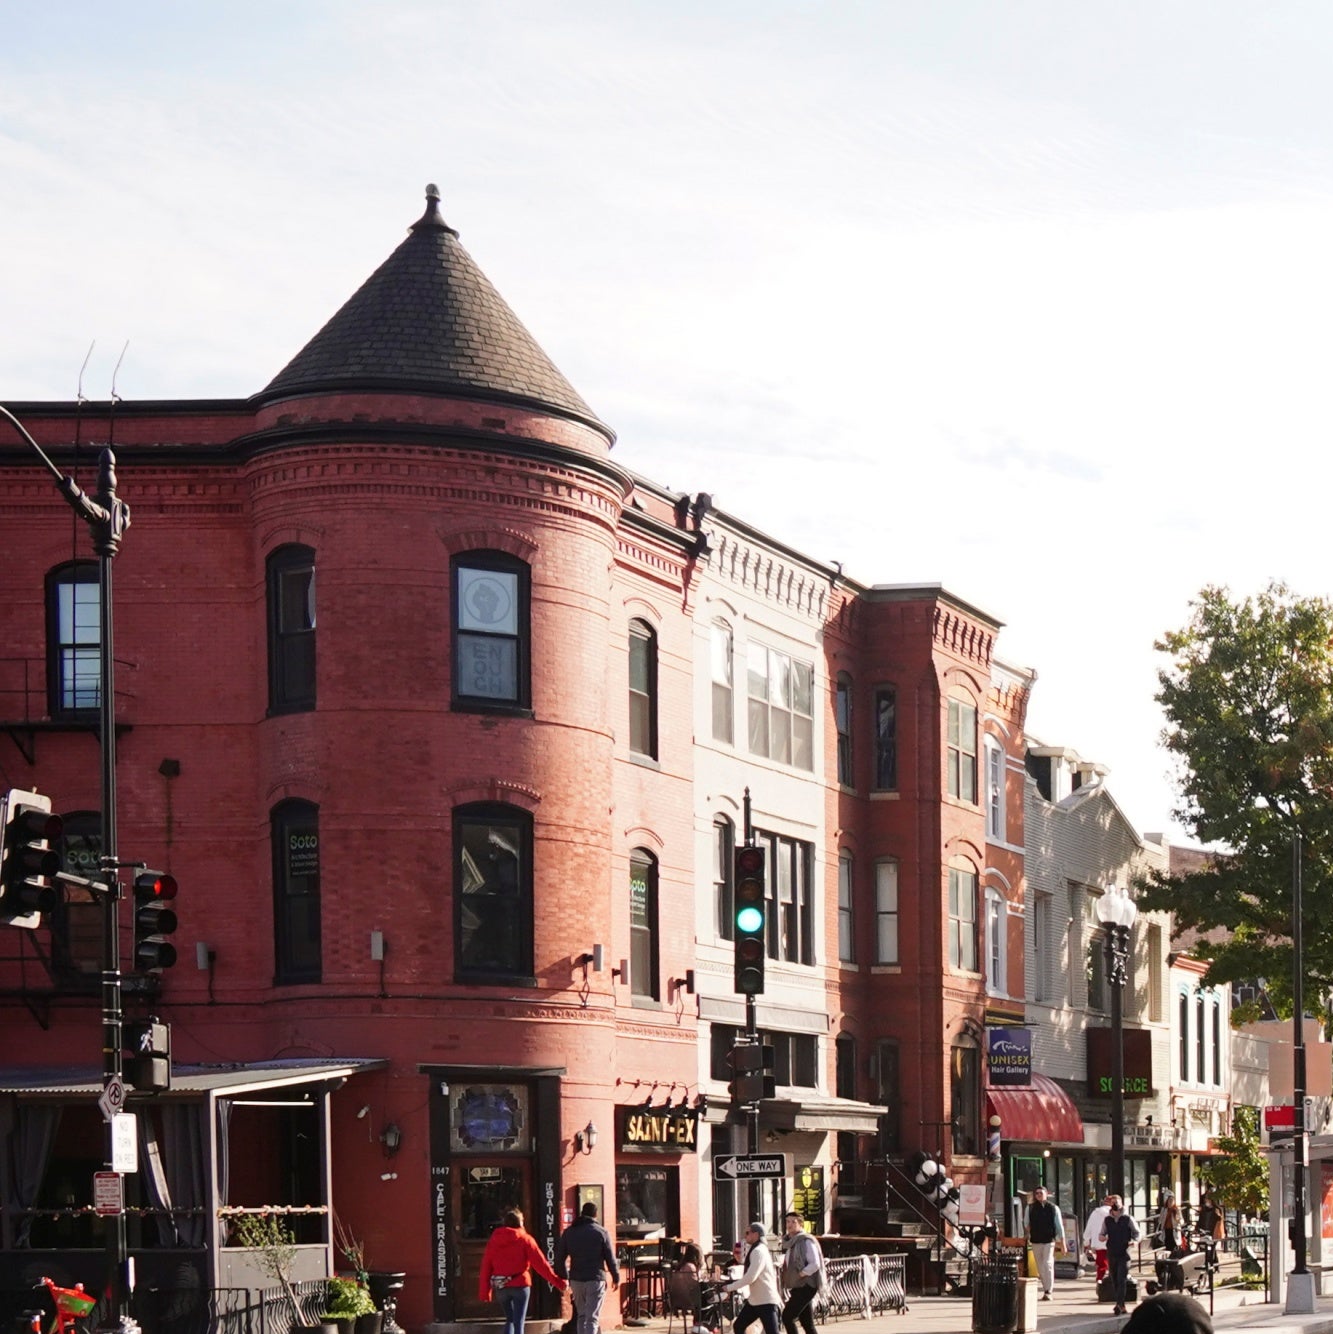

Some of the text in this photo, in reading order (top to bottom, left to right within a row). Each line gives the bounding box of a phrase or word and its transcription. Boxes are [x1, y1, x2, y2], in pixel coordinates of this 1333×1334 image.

[290, 834, 318, 850] Soto
[990, 1055, 1029, 1065] UNISEX
[1006, 1066, 1029, 1075] Gallery
[628, 1115, 695, 1143] SAINT-EX
[432, 1167, 450, 1175] 1847
[736, 1161, 778, 1172] ONE WAY
[437, 1223, 447, 1297] BRASSERIE
